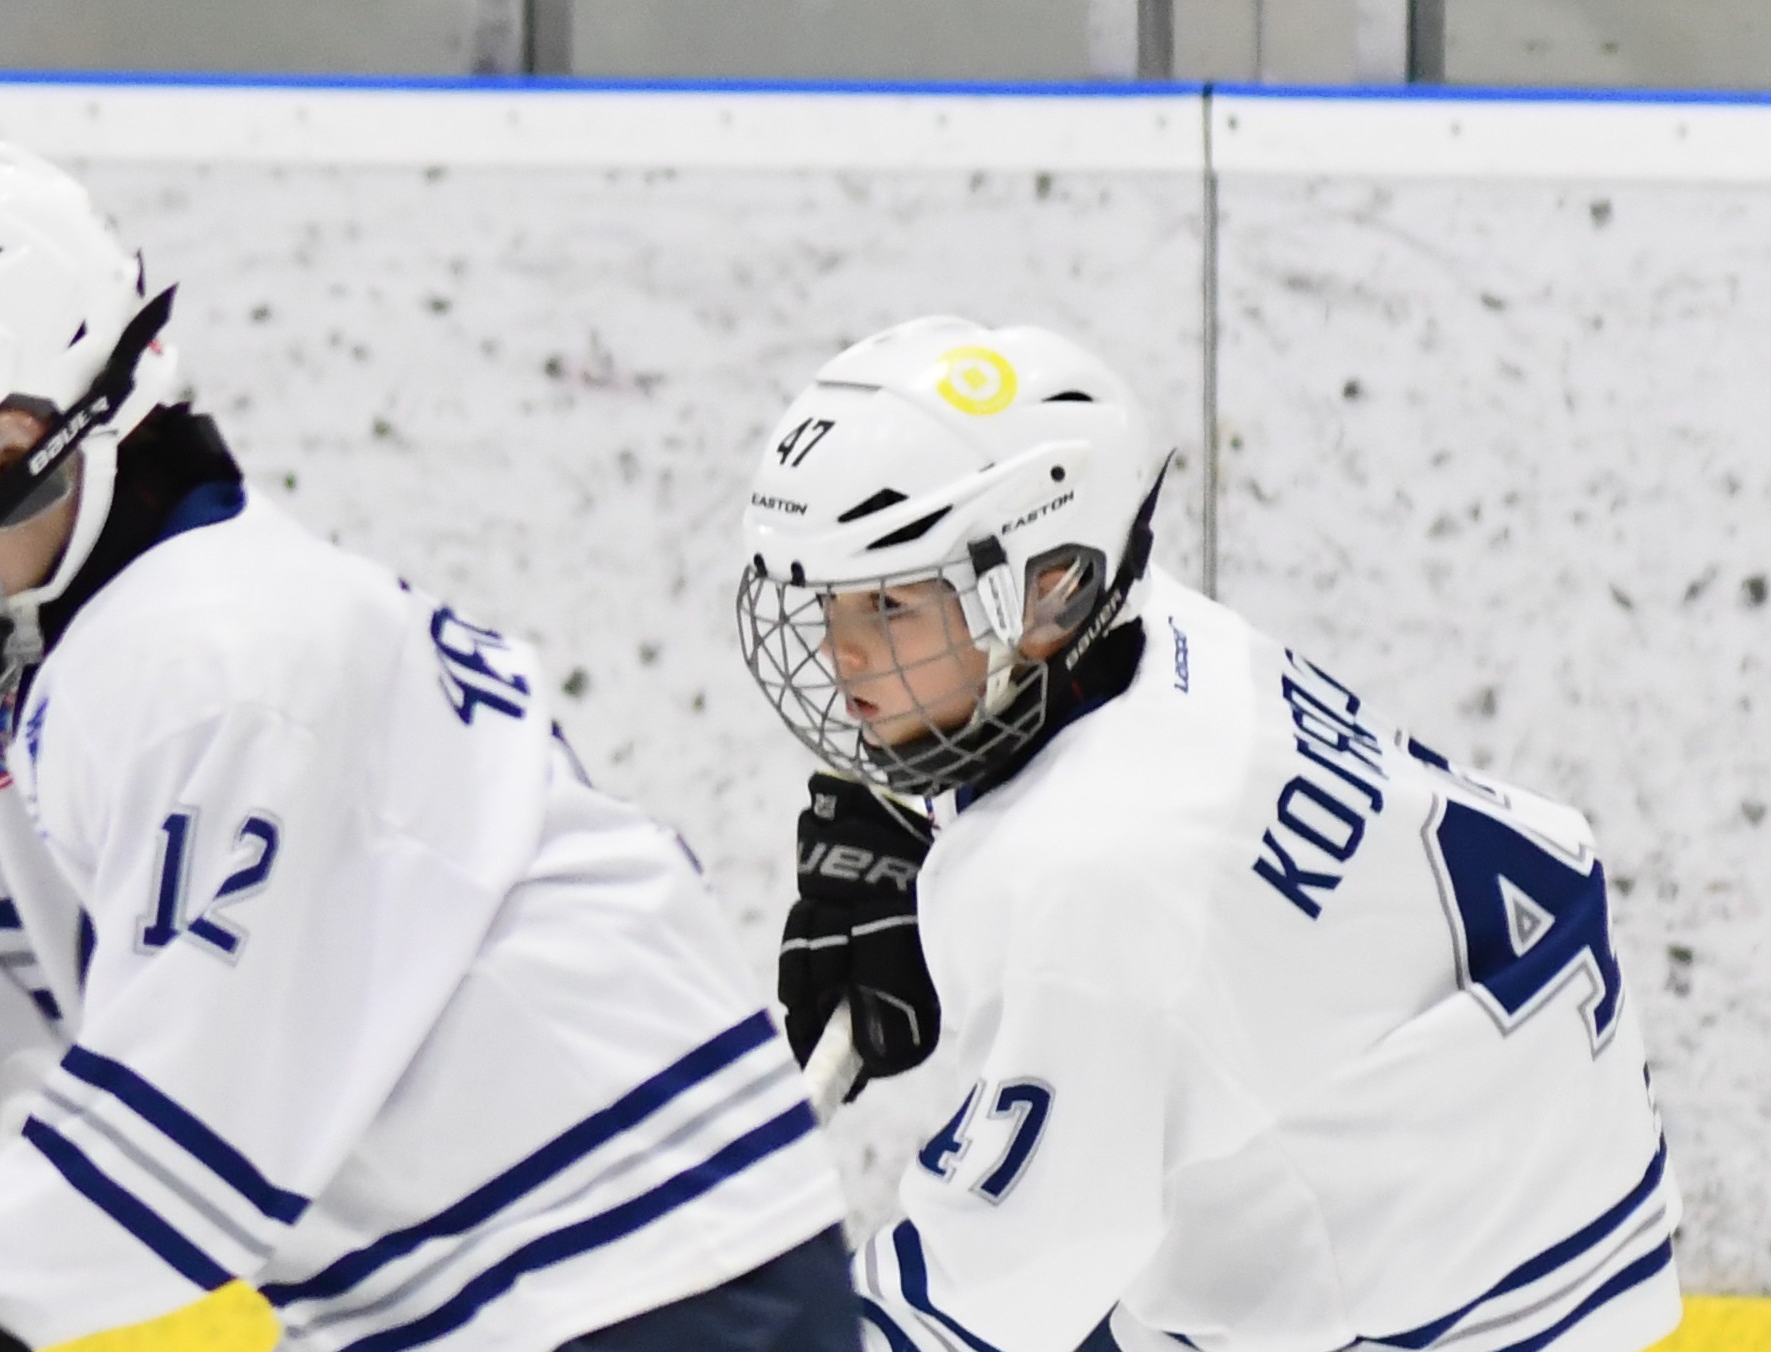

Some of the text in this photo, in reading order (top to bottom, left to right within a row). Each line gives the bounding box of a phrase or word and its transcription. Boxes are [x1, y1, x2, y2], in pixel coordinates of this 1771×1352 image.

[775, 417, 836, 468] 47
[751, 491, 809, 516] EASTON
[1001, 489, 1075, 536] EASTON
[135, 805, 283, 965] 12
[917, 1079, 1056, 1207] 47
